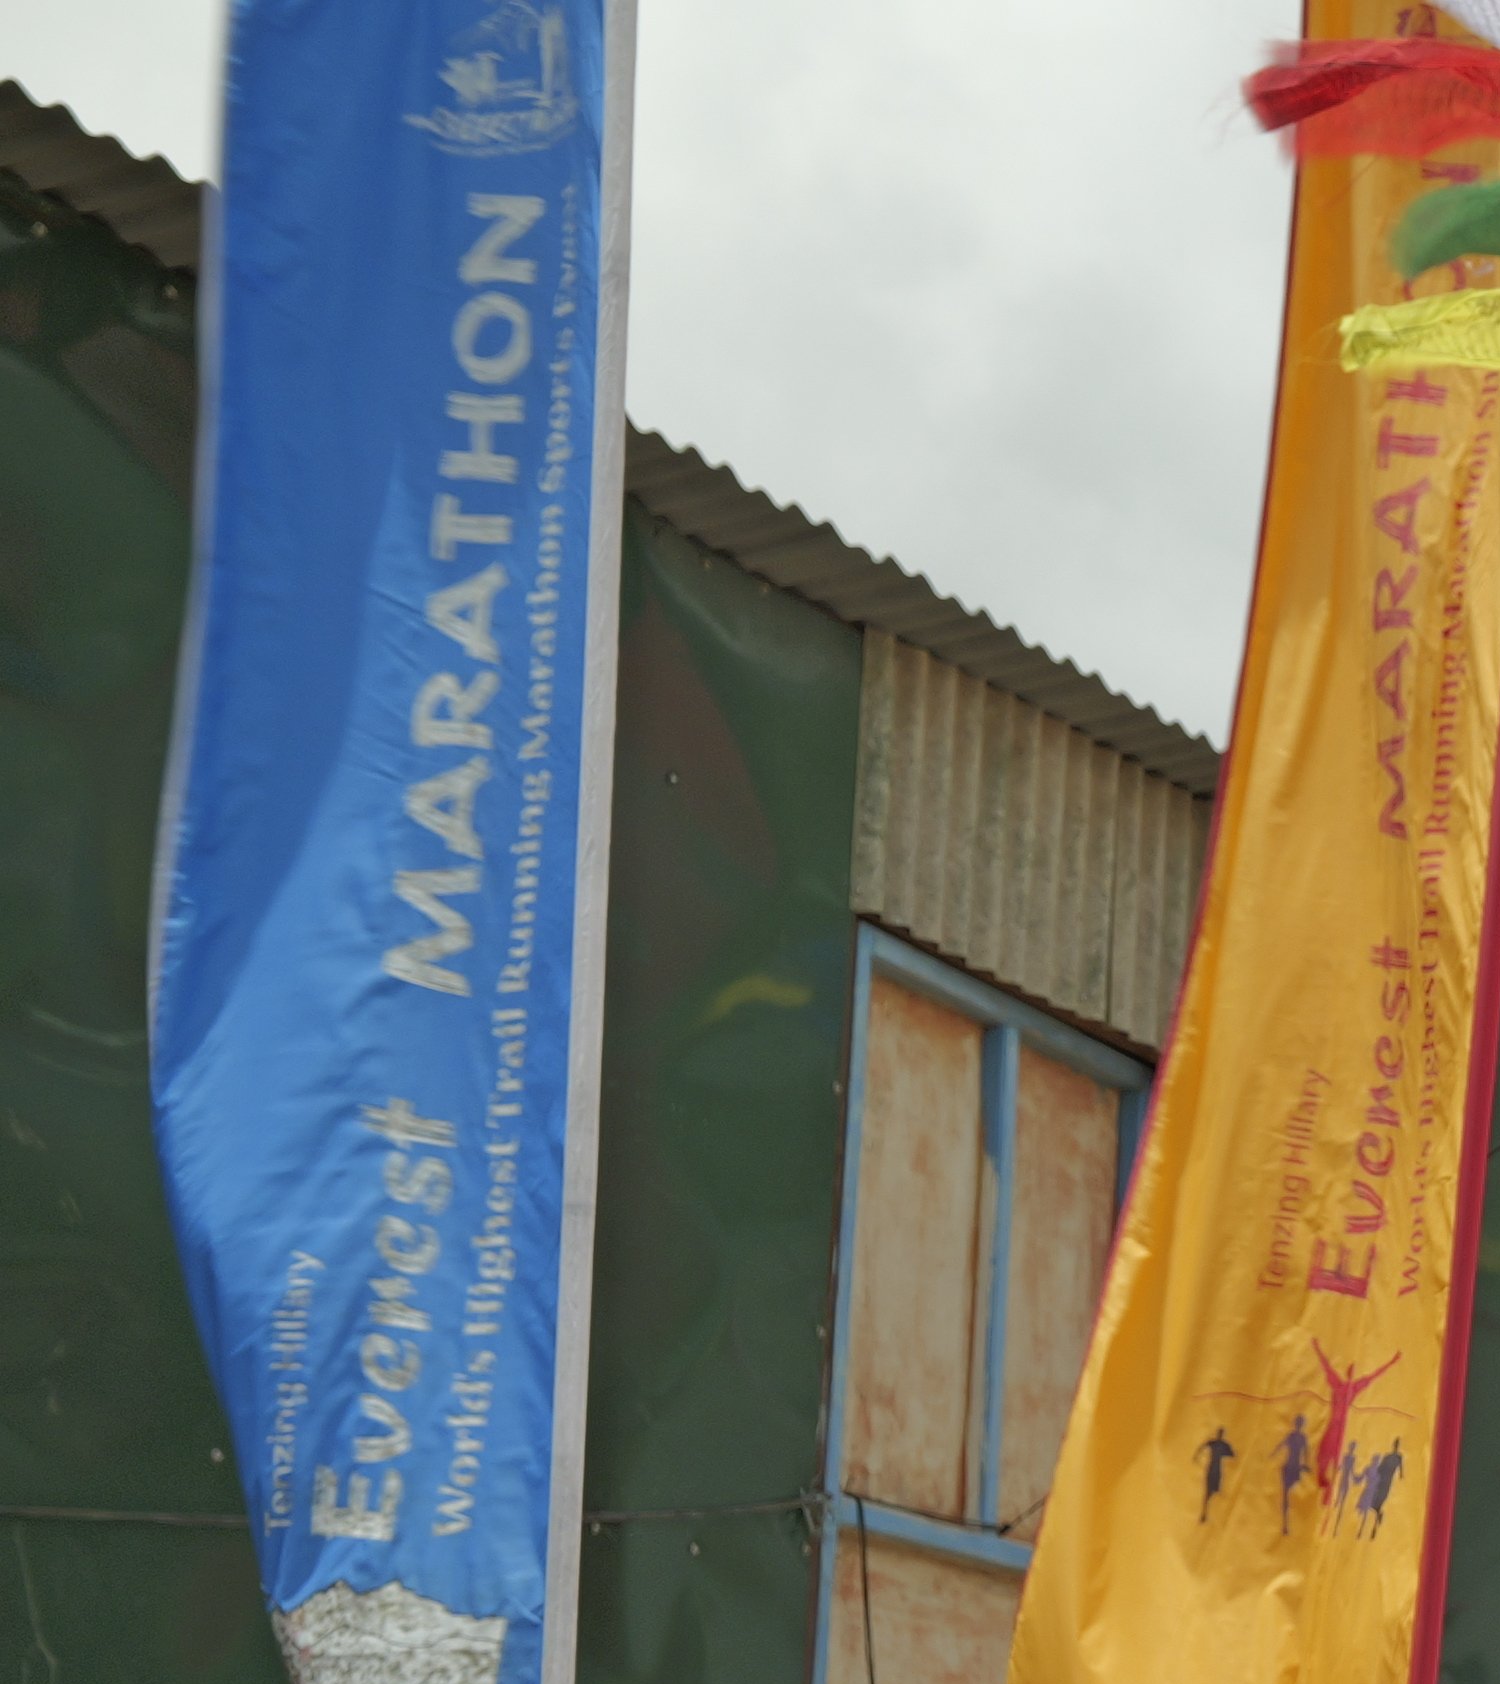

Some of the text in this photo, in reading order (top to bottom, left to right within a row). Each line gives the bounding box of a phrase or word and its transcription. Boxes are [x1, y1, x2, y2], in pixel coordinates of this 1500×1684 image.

[518, 492, 564, 764] Marathon
[311, 193, 546, 1543] Everest MARATHON
[495, 768, 550, 995] Running
[487, 1008, 528, 1128] Trail
[1258, 1068, 1332, 1294] Tenzing Hillary
[1309, 934, 1413, 1300] Everest
[463, 1137, 522, 1337] Highest
[264, 1249, 325, 1537] Tenzing Hillary
